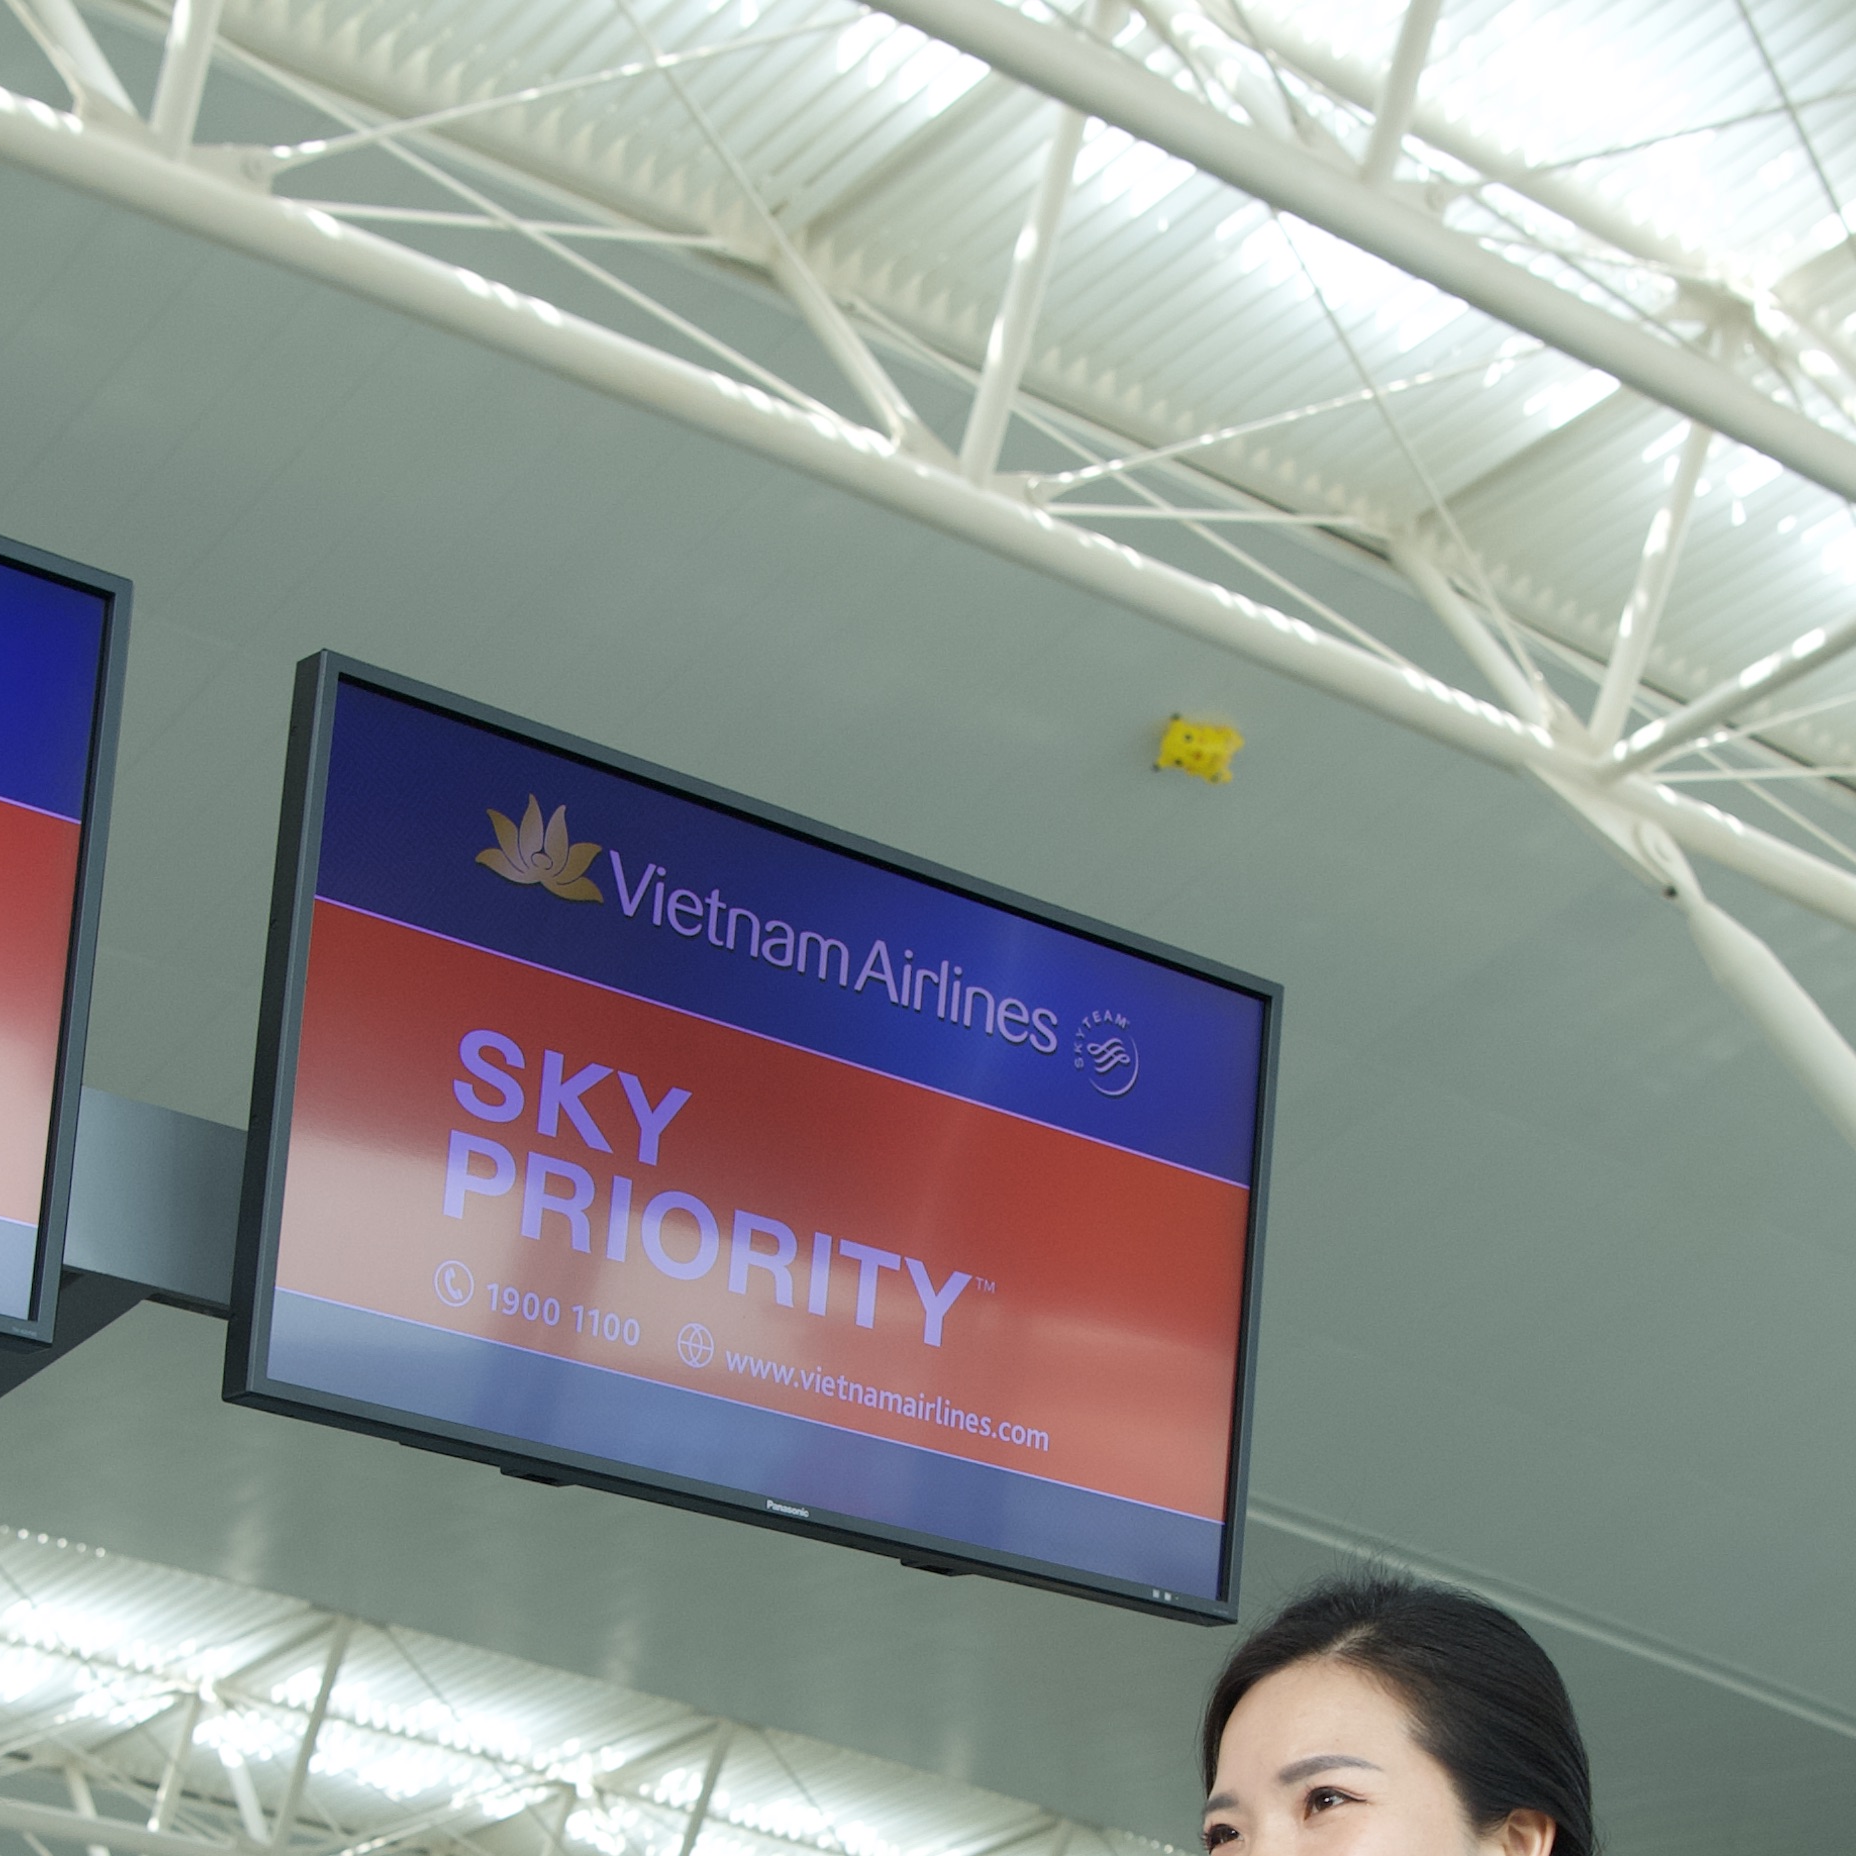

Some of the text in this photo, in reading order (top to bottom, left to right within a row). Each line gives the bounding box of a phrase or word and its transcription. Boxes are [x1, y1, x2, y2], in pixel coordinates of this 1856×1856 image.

[451, 1027, 693, 1167] SKY
[442, 1129, 973, 1349] PRIORITY
[485, 1282, 641, 1348] 1900 1100
[725, 1349, 1050, 1453] www.vietnamairlines.com
[765, 1498, 810, 1519] Panasonic
